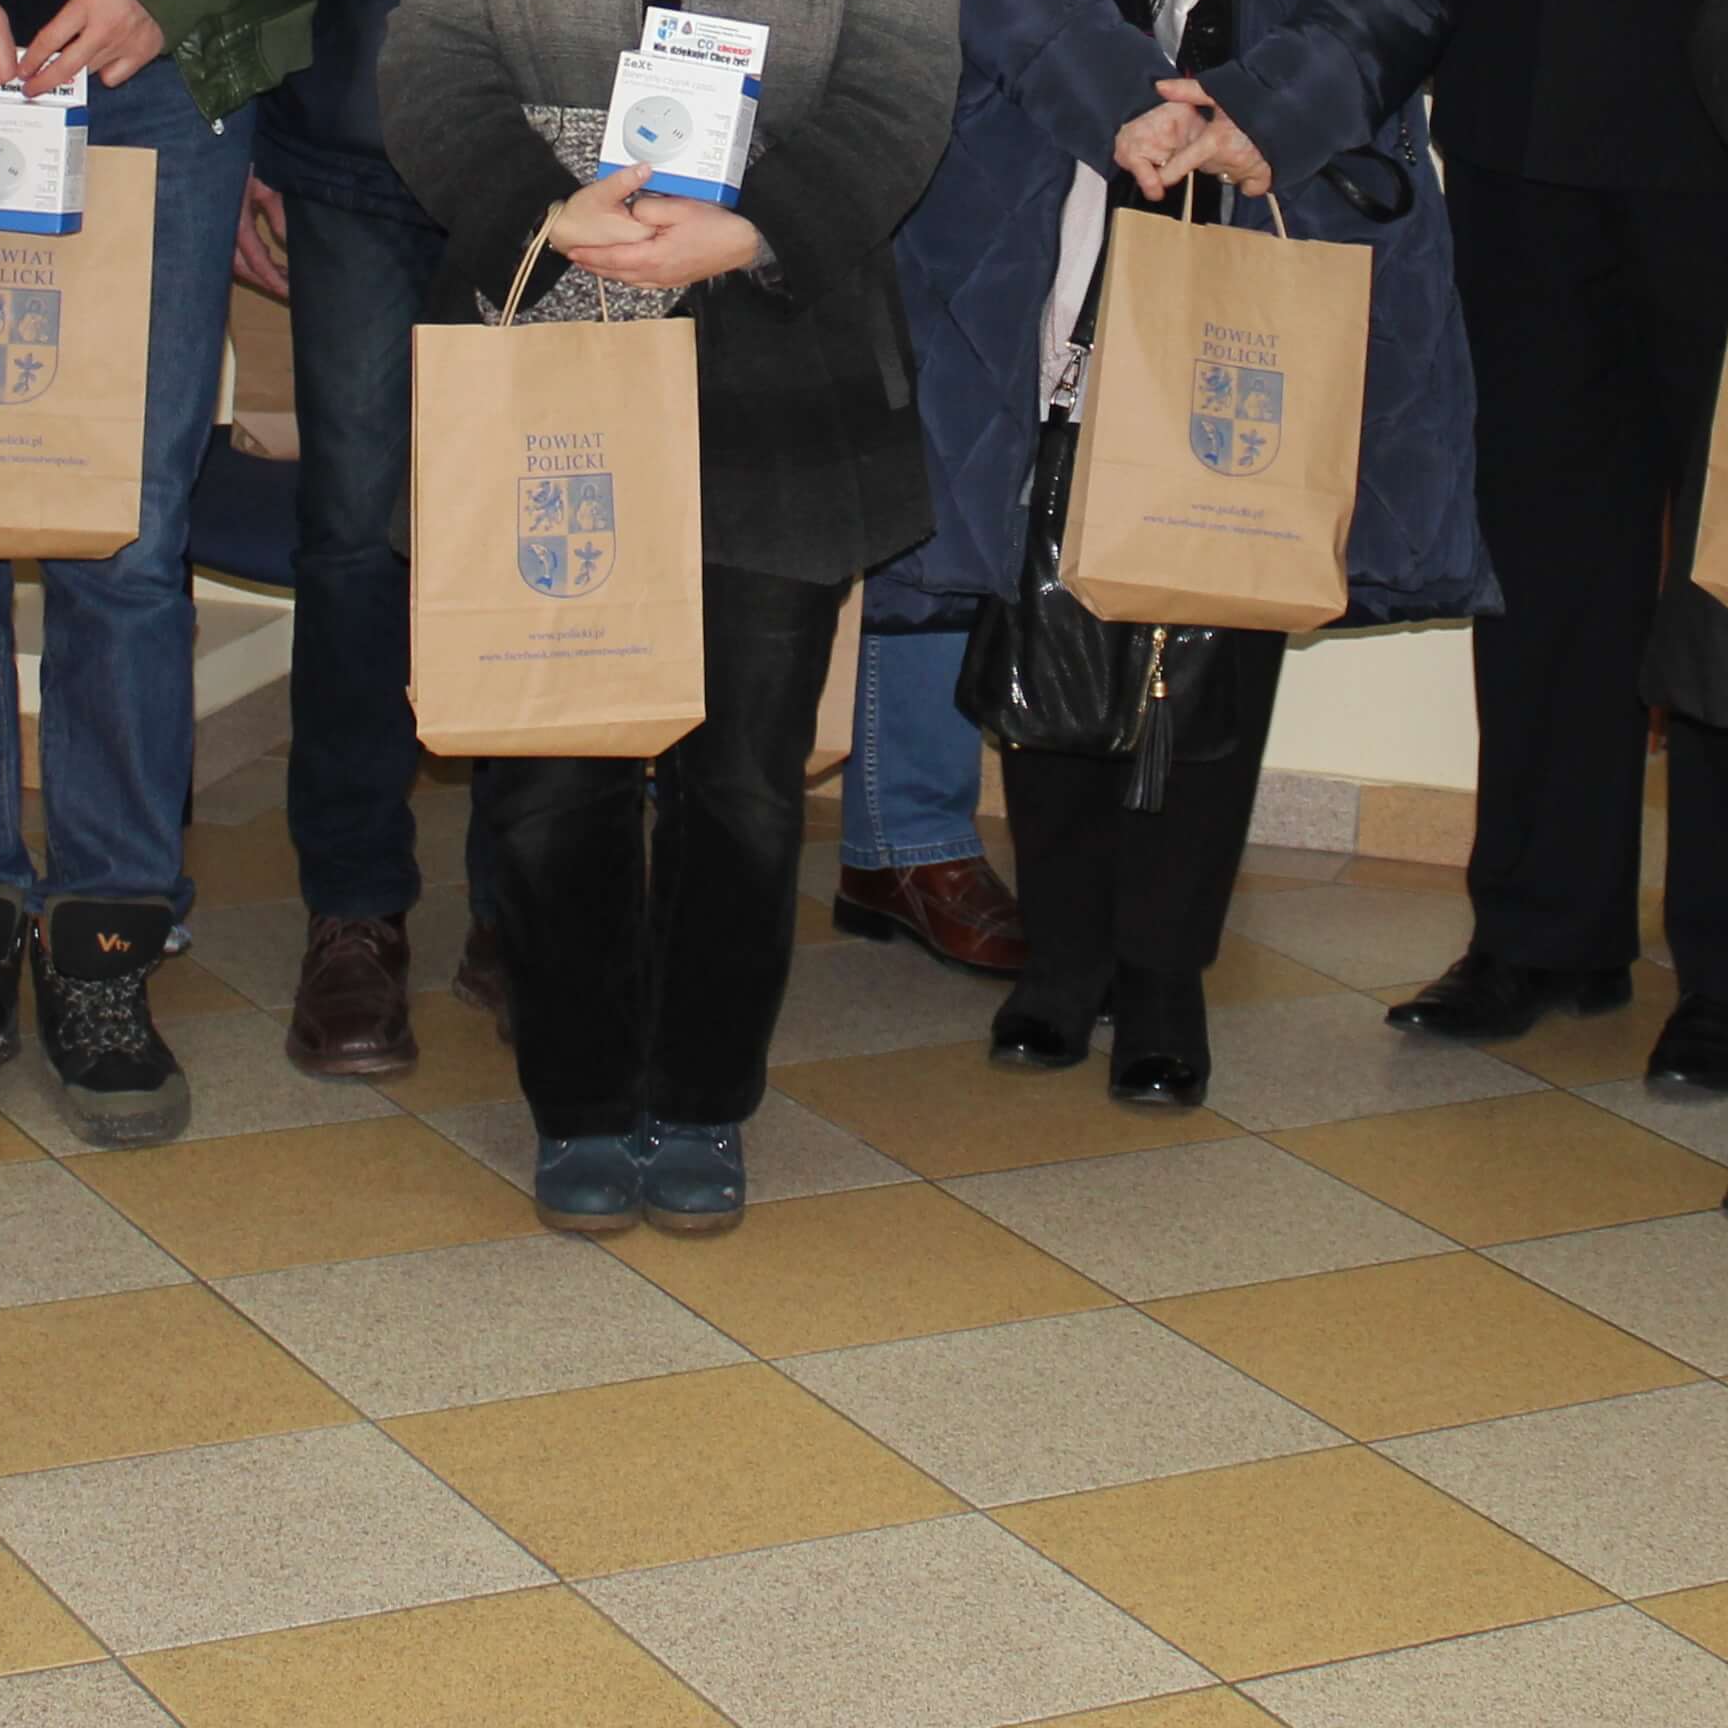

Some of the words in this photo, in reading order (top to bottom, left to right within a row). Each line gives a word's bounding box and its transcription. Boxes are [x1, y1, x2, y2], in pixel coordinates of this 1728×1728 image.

[1204, 321, 1280, 349] POWIAT
[1202, 341, 1279, 367] POLICKI
[527, 433, 605, 452] POWIAT
[527, 453, 605, 473] POLICKI
